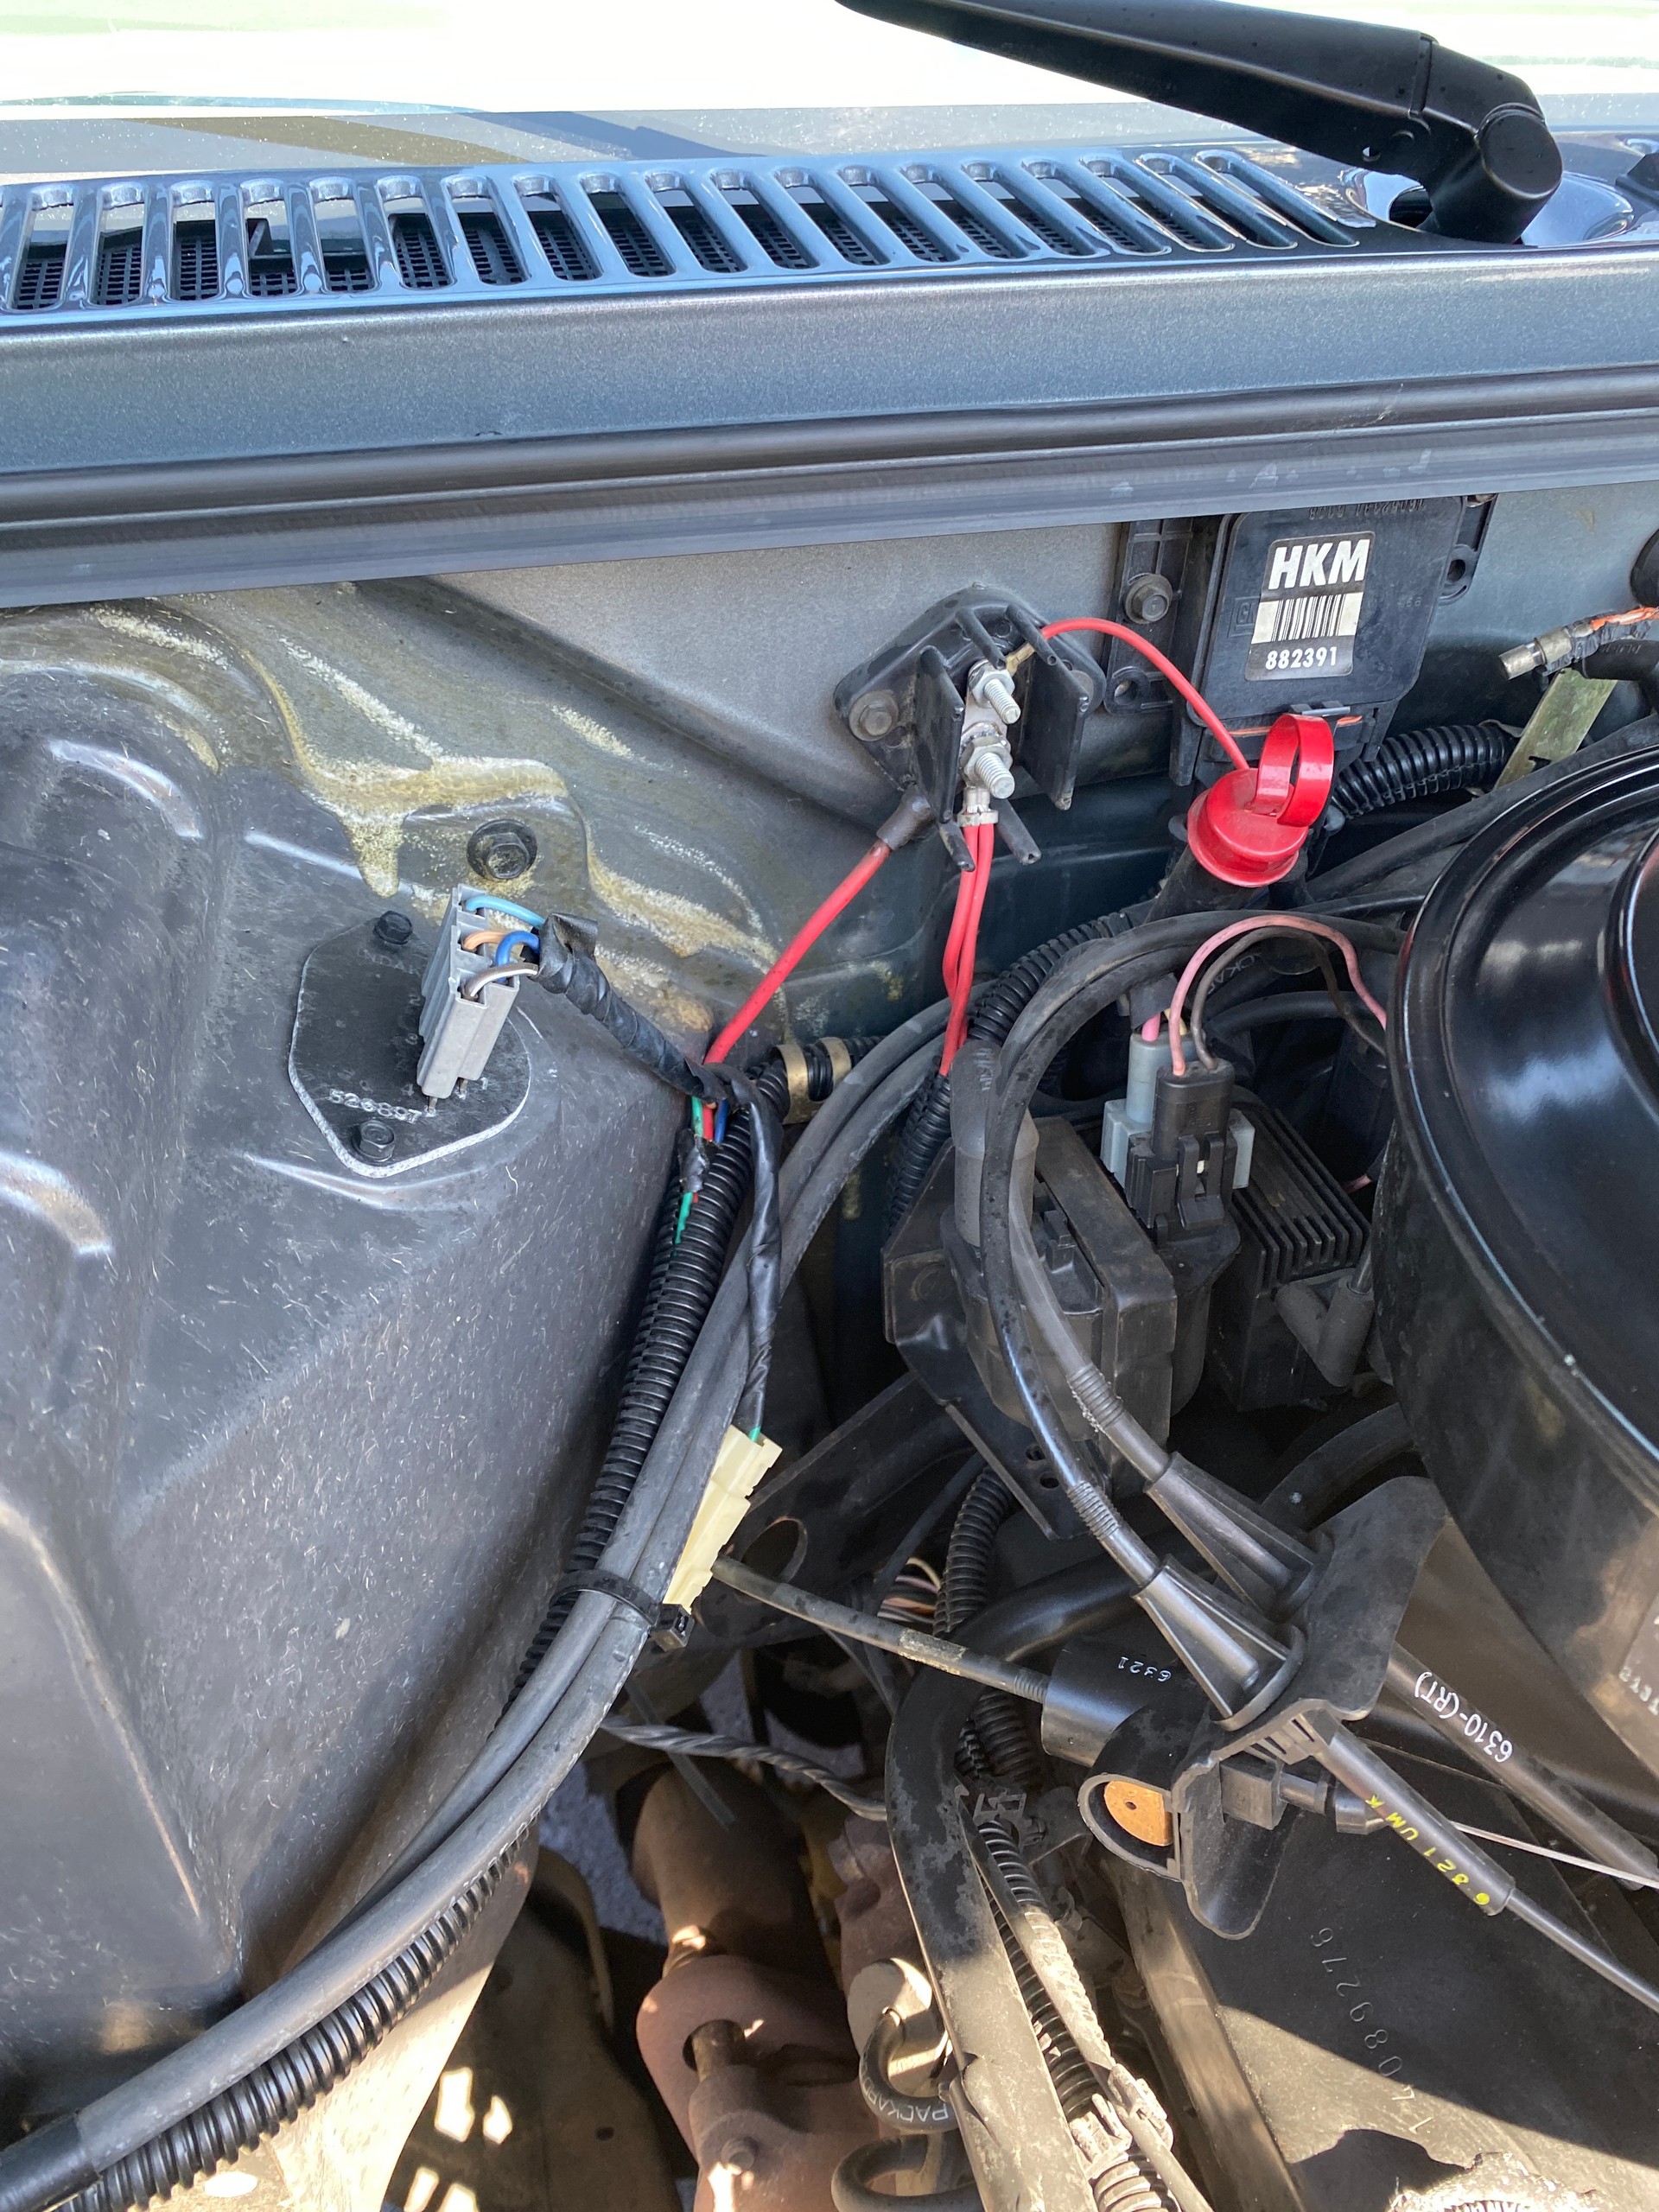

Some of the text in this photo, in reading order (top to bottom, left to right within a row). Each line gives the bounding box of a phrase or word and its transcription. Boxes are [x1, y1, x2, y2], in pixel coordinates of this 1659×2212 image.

[1268, 538, 1371, 590] HKM
[1264, 645, 1338, 671] 882391
[1116, 1655, 1173, 1683] 6321
[1414, 1671, 1514, 1764] 6310-(RT)
